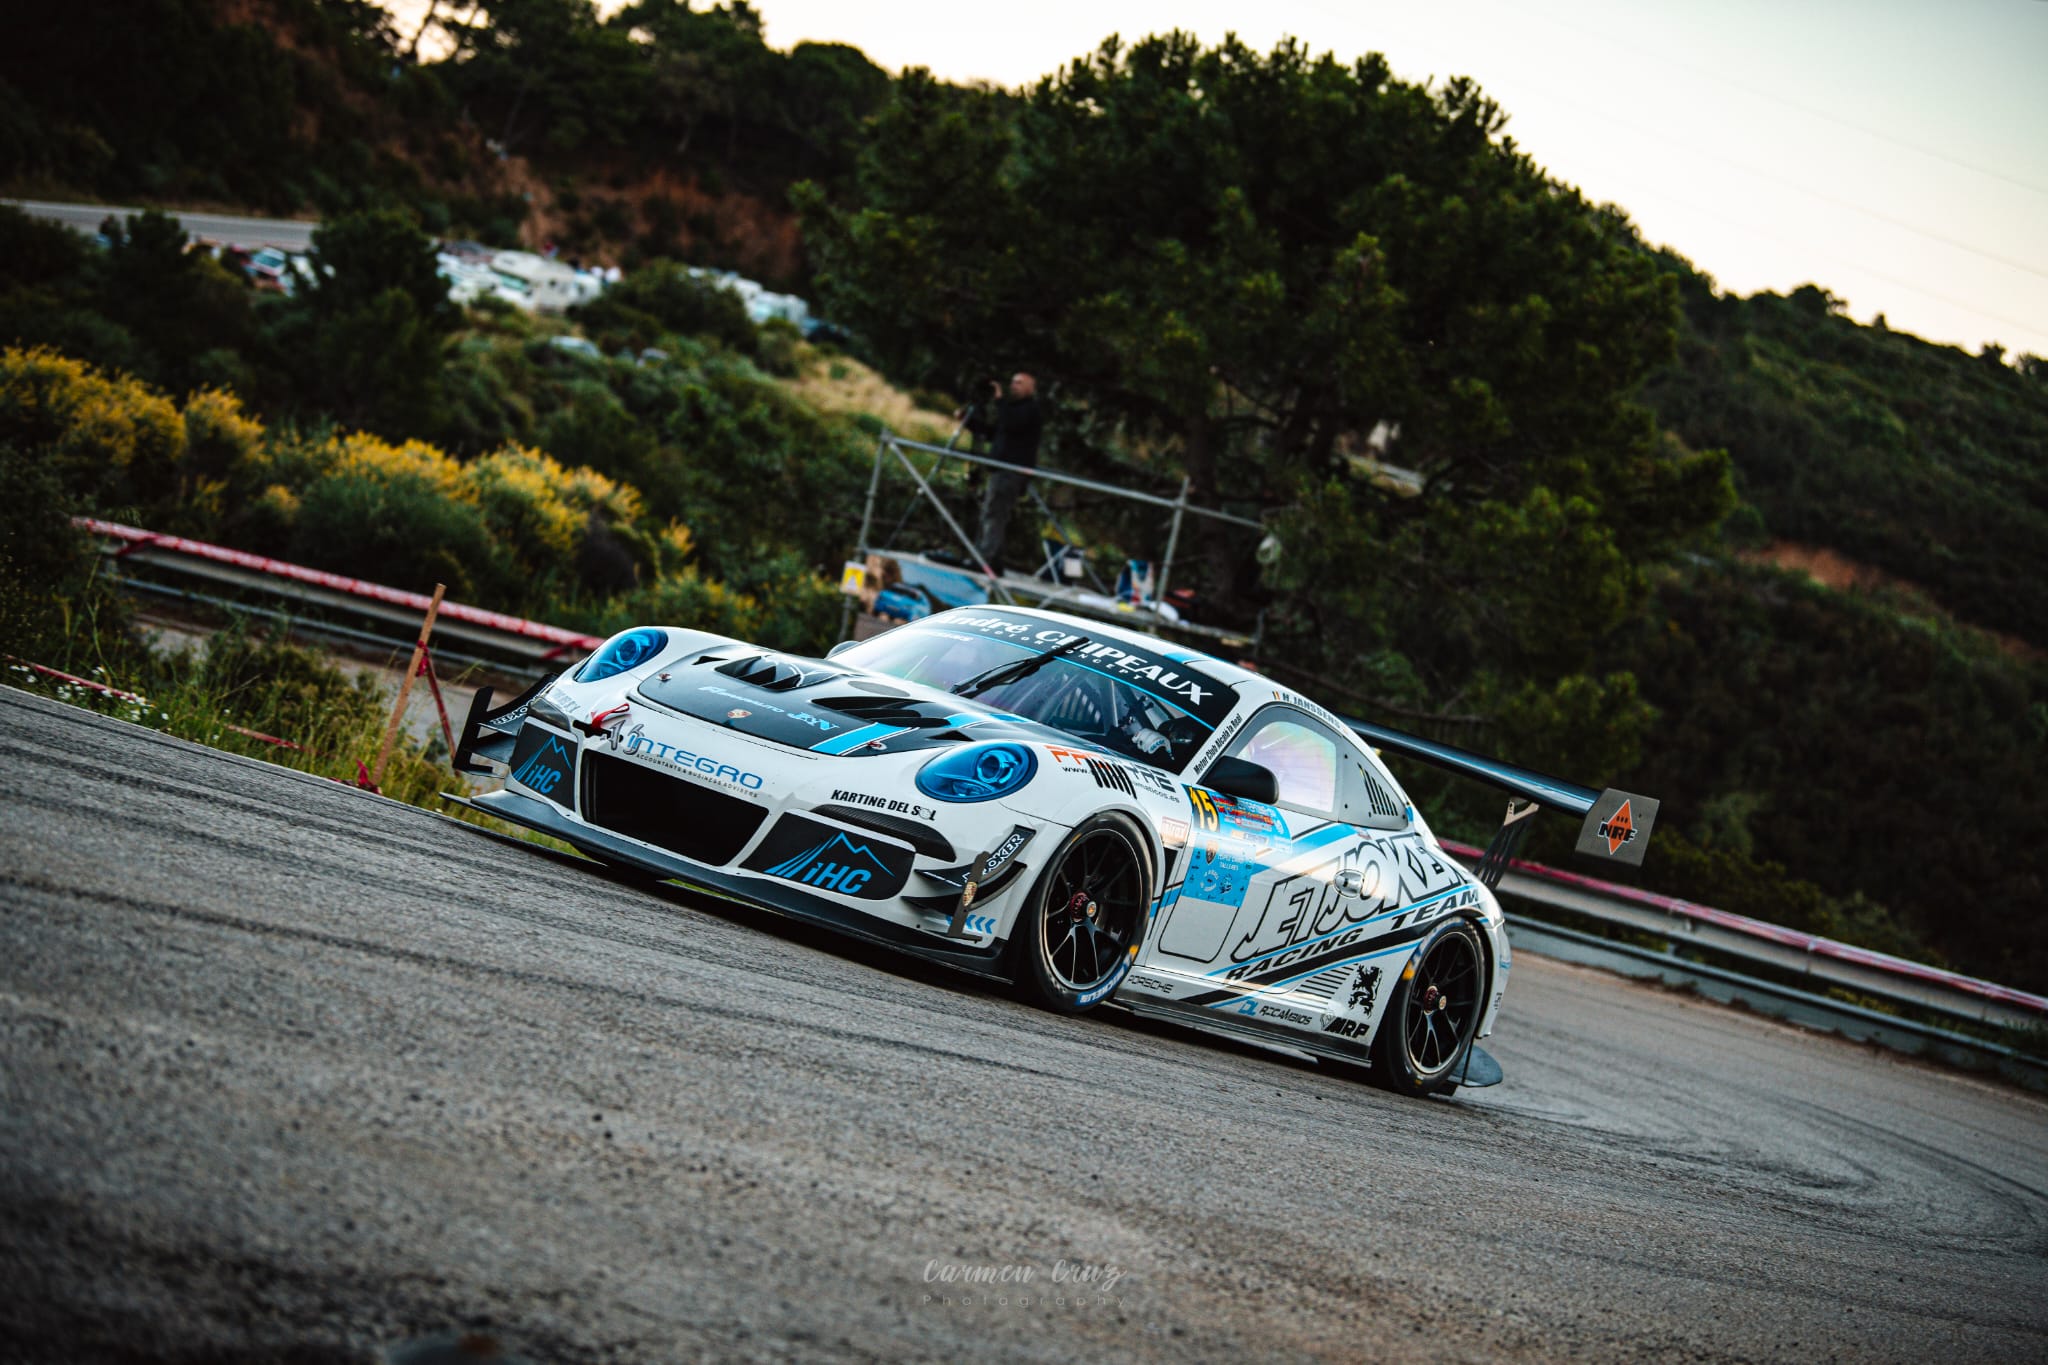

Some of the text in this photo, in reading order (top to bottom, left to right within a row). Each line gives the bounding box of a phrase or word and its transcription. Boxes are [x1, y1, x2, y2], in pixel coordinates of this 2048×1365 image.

[831, 789, 886, 808] KARTING
[887, 799, 909, 814] DEL
[1189, 786, 1219, 833] 15
[1226, 928, 1364, 981] RACING
[1391, 888, 1480, 931] TEAM
[1128, 974, 1174, 994] PORSCHE
